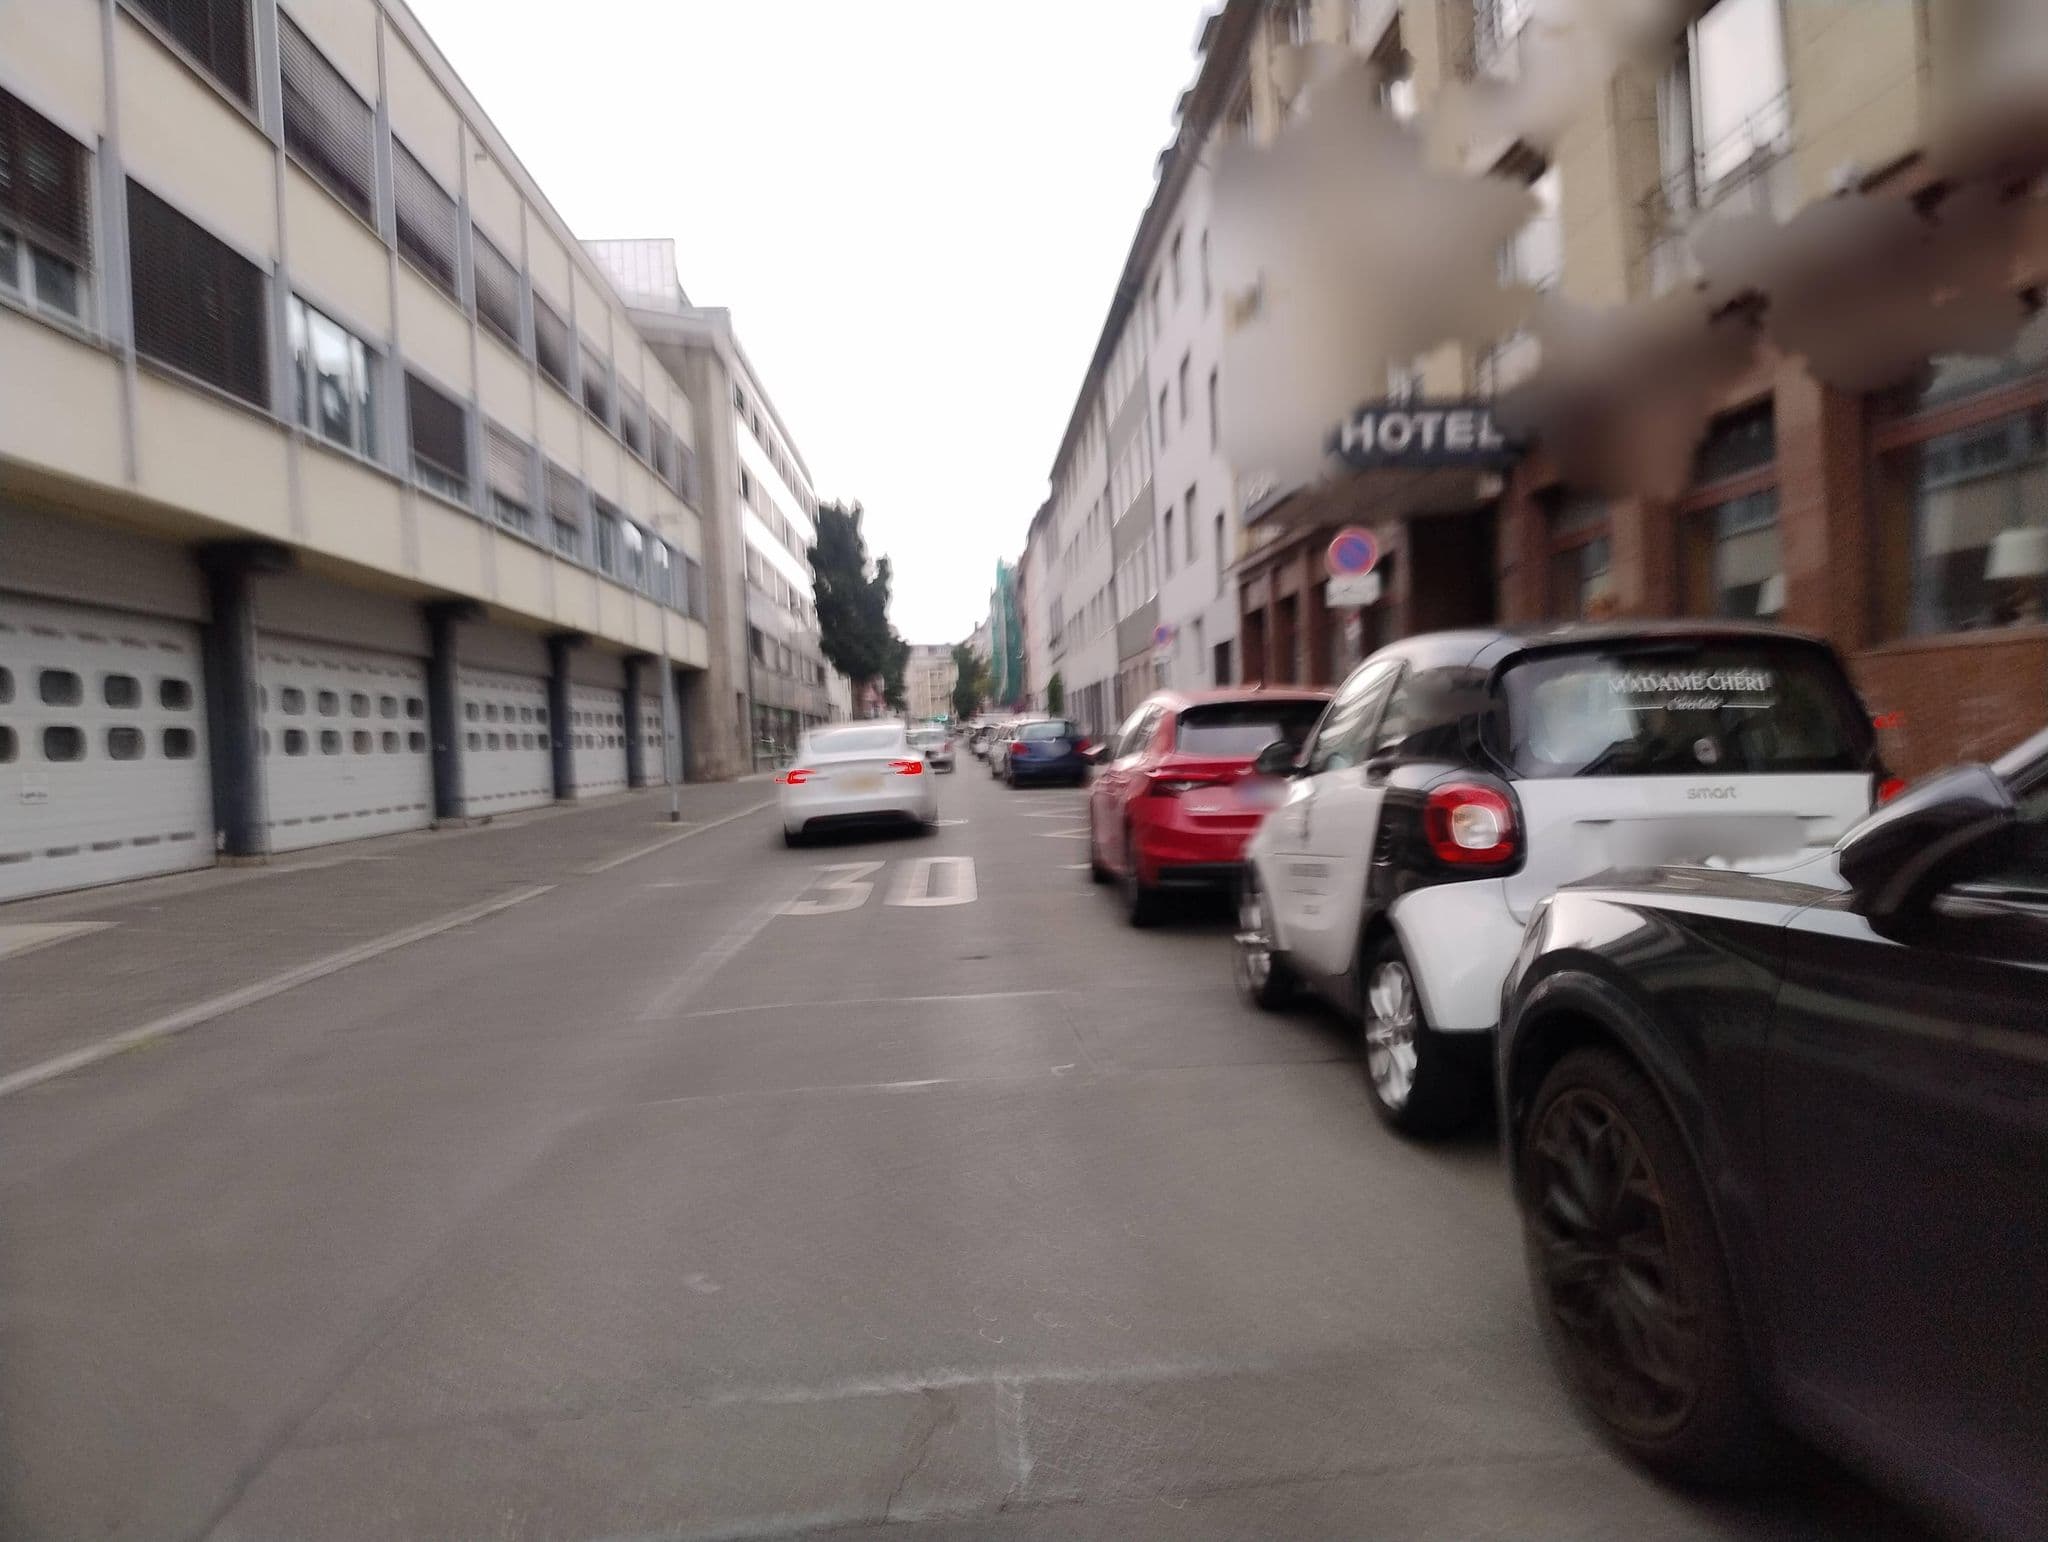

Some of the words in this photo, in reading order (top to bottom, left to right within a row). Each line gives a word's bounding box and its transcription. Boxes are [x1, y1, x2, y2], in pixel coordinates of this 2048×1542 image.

[1341, 409, 1505, 455] HOTEL
[1608, 674, 1703, 693] MADAME
[1687, 786, 1736, 800] smart
[776, 856, 978, 915] 30
